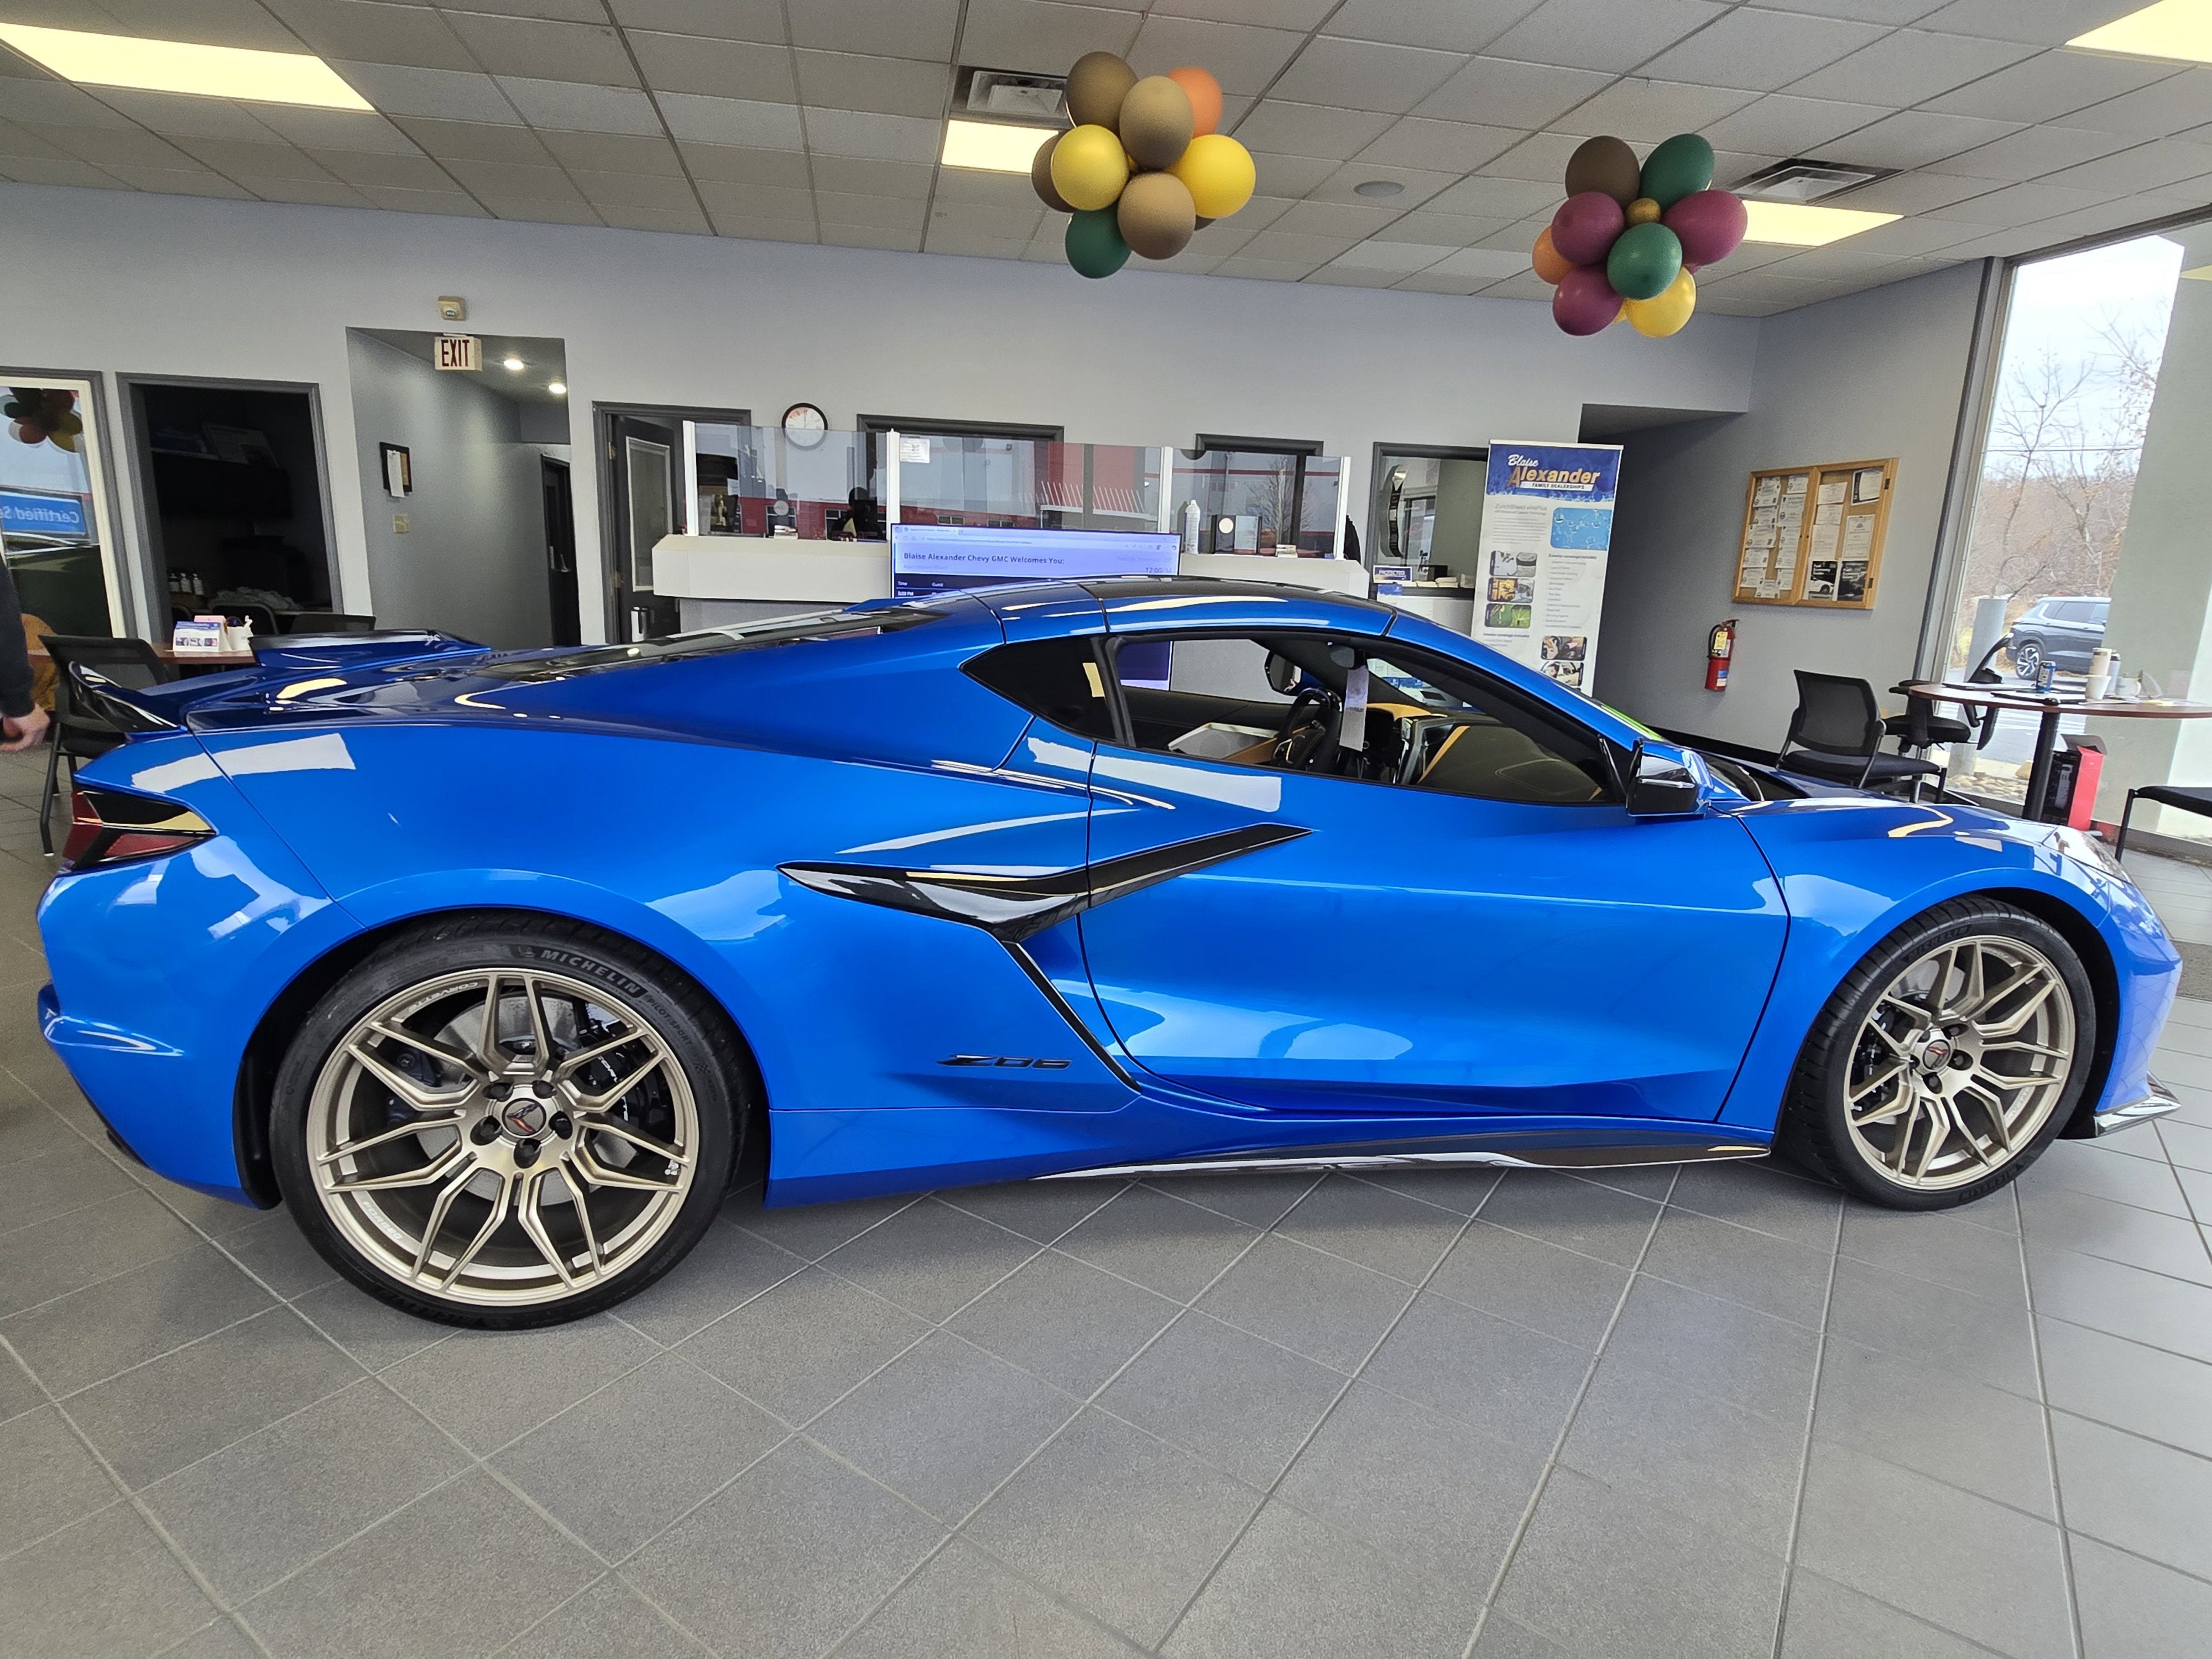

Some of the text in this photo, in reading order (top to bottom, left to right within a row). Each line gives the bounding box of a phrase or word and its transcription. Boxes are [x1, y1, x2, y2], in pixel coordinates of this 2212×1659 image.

[441, 338, 470, 367] EXIT
[1508, 454, 1539, 467] Blaise
[1506, 466, 1601, 488] Alexander
[928, 553, 966, 561] Alexander
[967, 555, 989, 563] Chevy
[408, 982, 478, 1013] CORVETTE
[540, 949, 641, 994] MICHELIN
[646, 998, 671, 1019] PILOT
[669, 1020, 693, 1046] SPORT
[935, 1053, 1073, 1070] Z06
[362, 1201, 403, 1239] FORGED
